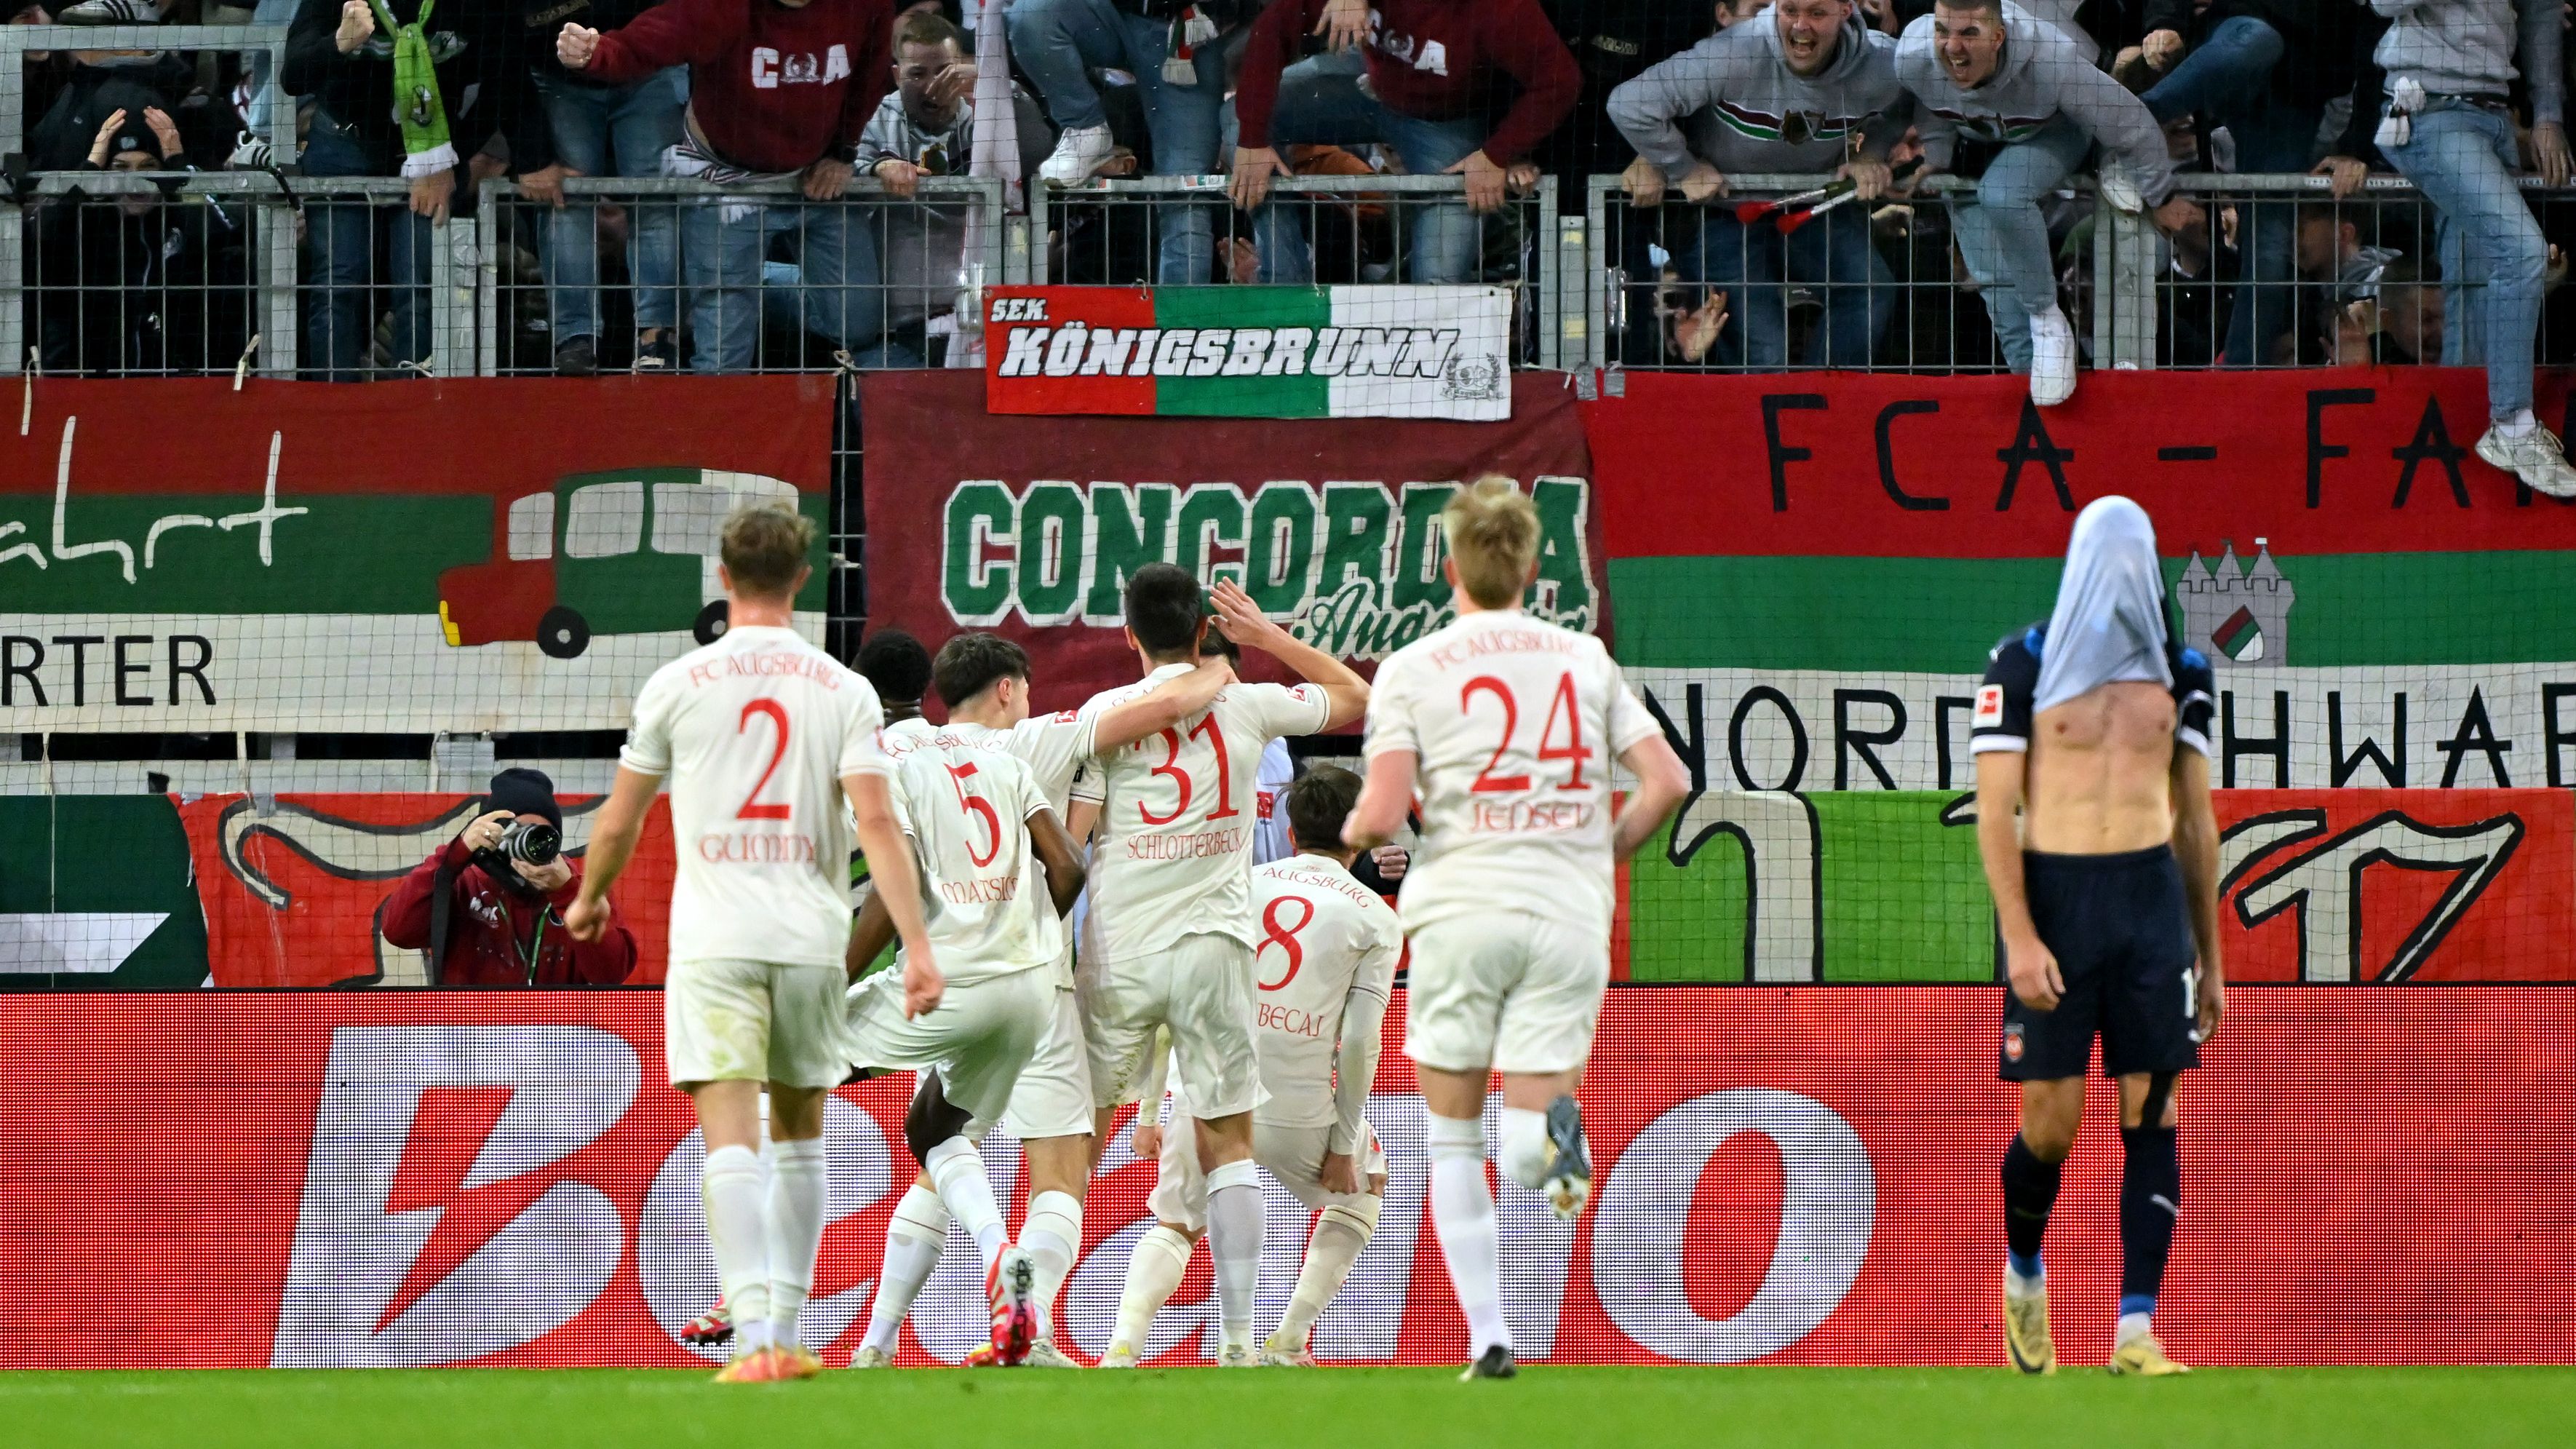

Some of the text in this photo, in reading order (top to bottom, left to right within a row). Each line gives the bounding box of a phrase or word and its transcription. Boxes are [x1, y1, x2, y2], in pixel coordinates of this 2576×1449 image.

[990, 298, 1049, 322] SEK.
[998, 321, 1460, 378] KÖNIGSBRUNN
[940, 475, 1599, 627] CONCORDA
[736, 698, 791, 821] 2
[1134, 711, 1239, 825] 31
[1460, 670, 1594, 794] 24
[943, 761, 1001, 868] 5
[1128, 827, 1242, 860] SCHLOTTERBECK
[942, 876, 1019, 904] MATSIM
[1263, 867, 1375, 908] AUGSBURG
[1256, 895, 1315, 991] 8
[1257, 1002, 1325, 1037] BECAJ
